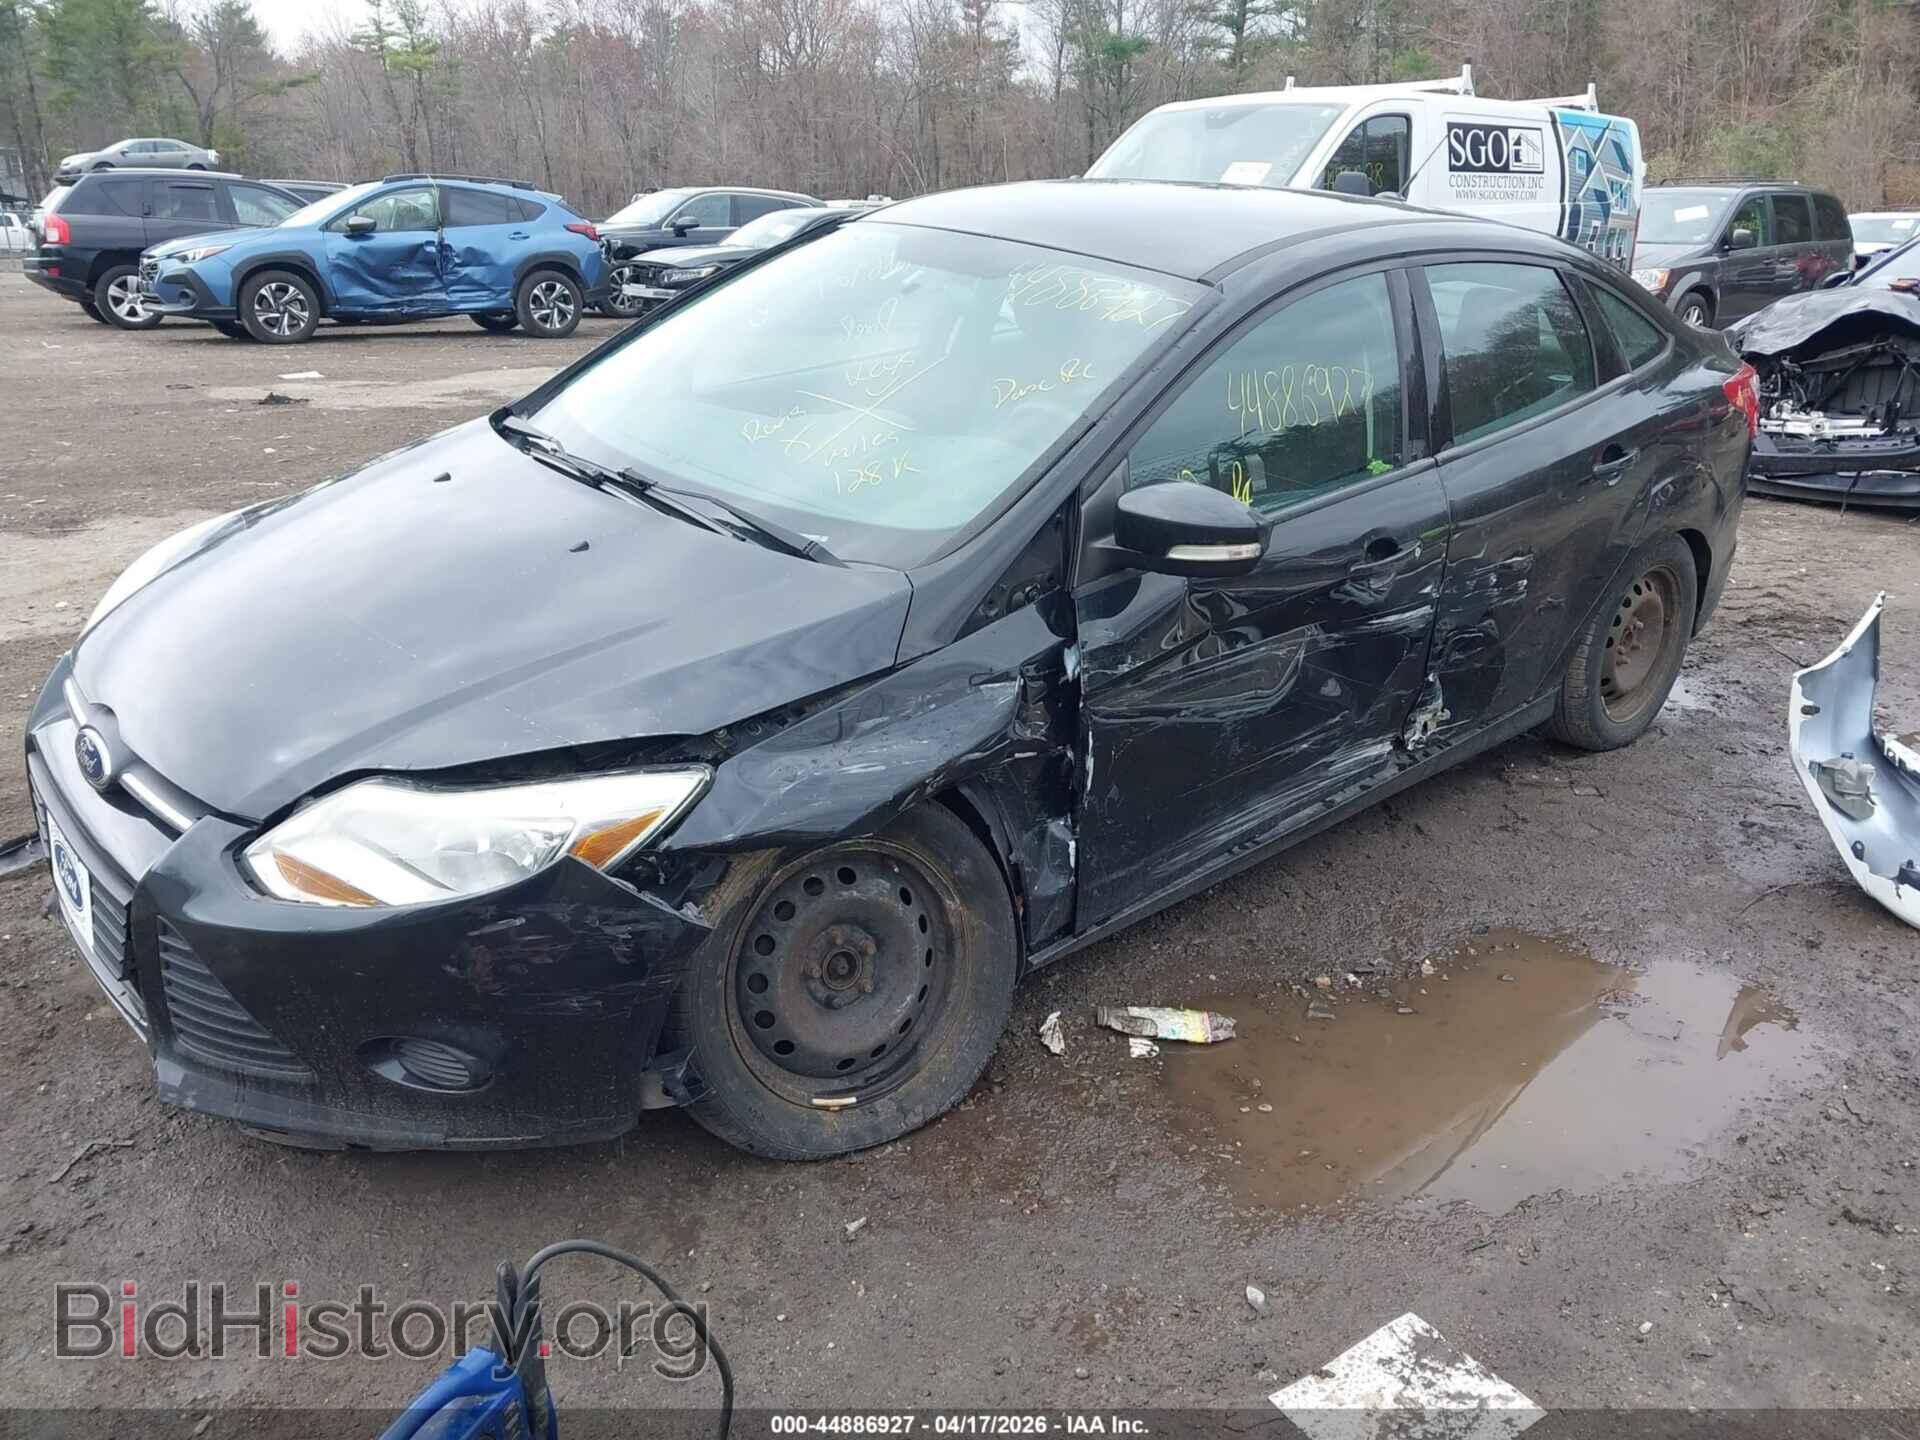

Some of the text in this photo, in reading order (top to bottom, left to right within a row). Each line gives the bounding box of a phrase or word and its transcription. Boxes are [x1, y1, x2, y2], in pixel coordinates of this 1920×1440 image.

[1450, 128, 1508, 168] SGO
[1448, 174, 1545, 189] CONSTRUCTION INC
[1226, 364, 1374, 437] 44886927
